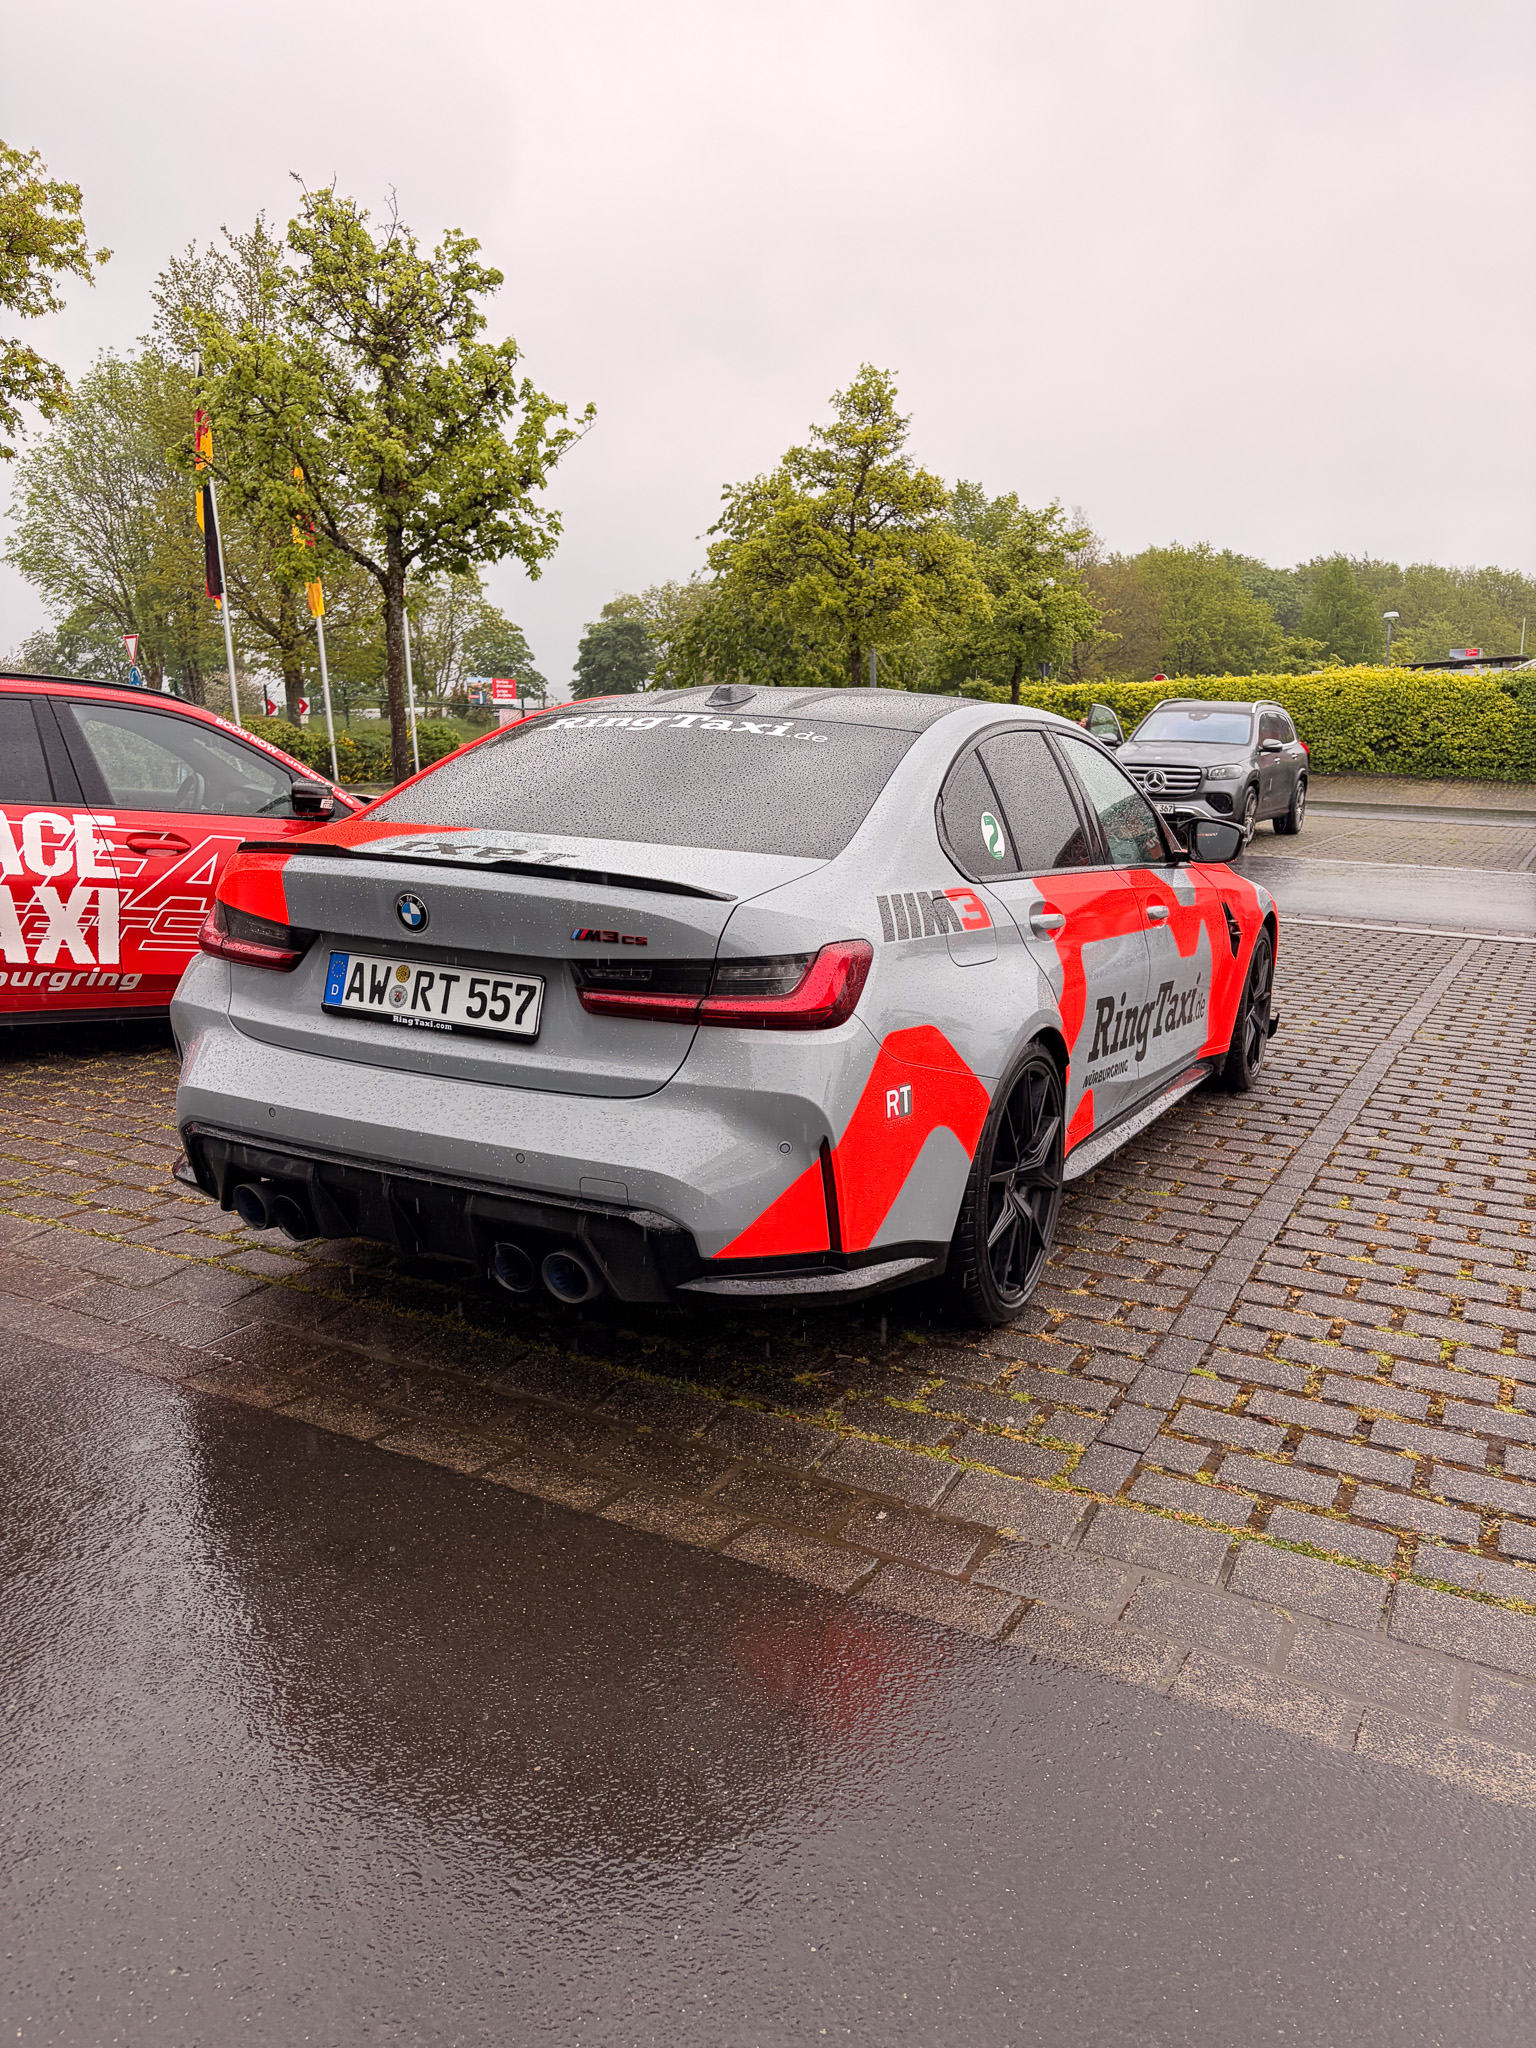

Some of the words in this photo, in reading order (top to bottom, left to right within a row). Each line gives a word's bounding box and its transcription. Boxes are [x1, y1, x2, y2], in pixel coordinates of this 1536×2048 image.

[215, 717, 248, 739] BOOK
[250, 735, 279, 754] NOW
[540, 714, 828, 743] RingTaxi.de
[1160, 804, 1173, 813] 367
[399, 895, 423, 909] BMW
[330, 984, 339, 996] D
[345, 962, 392, 1005] AW
[411, 970, 460, 1014] RT
[466, 977, 537, 1025] 557
[1087, 972, 1206, 1063] RingTaxi.de
[1081, 1059, 1129, 1089] NÜRBURGRING
[886, 1084, 912, 1119] RT
